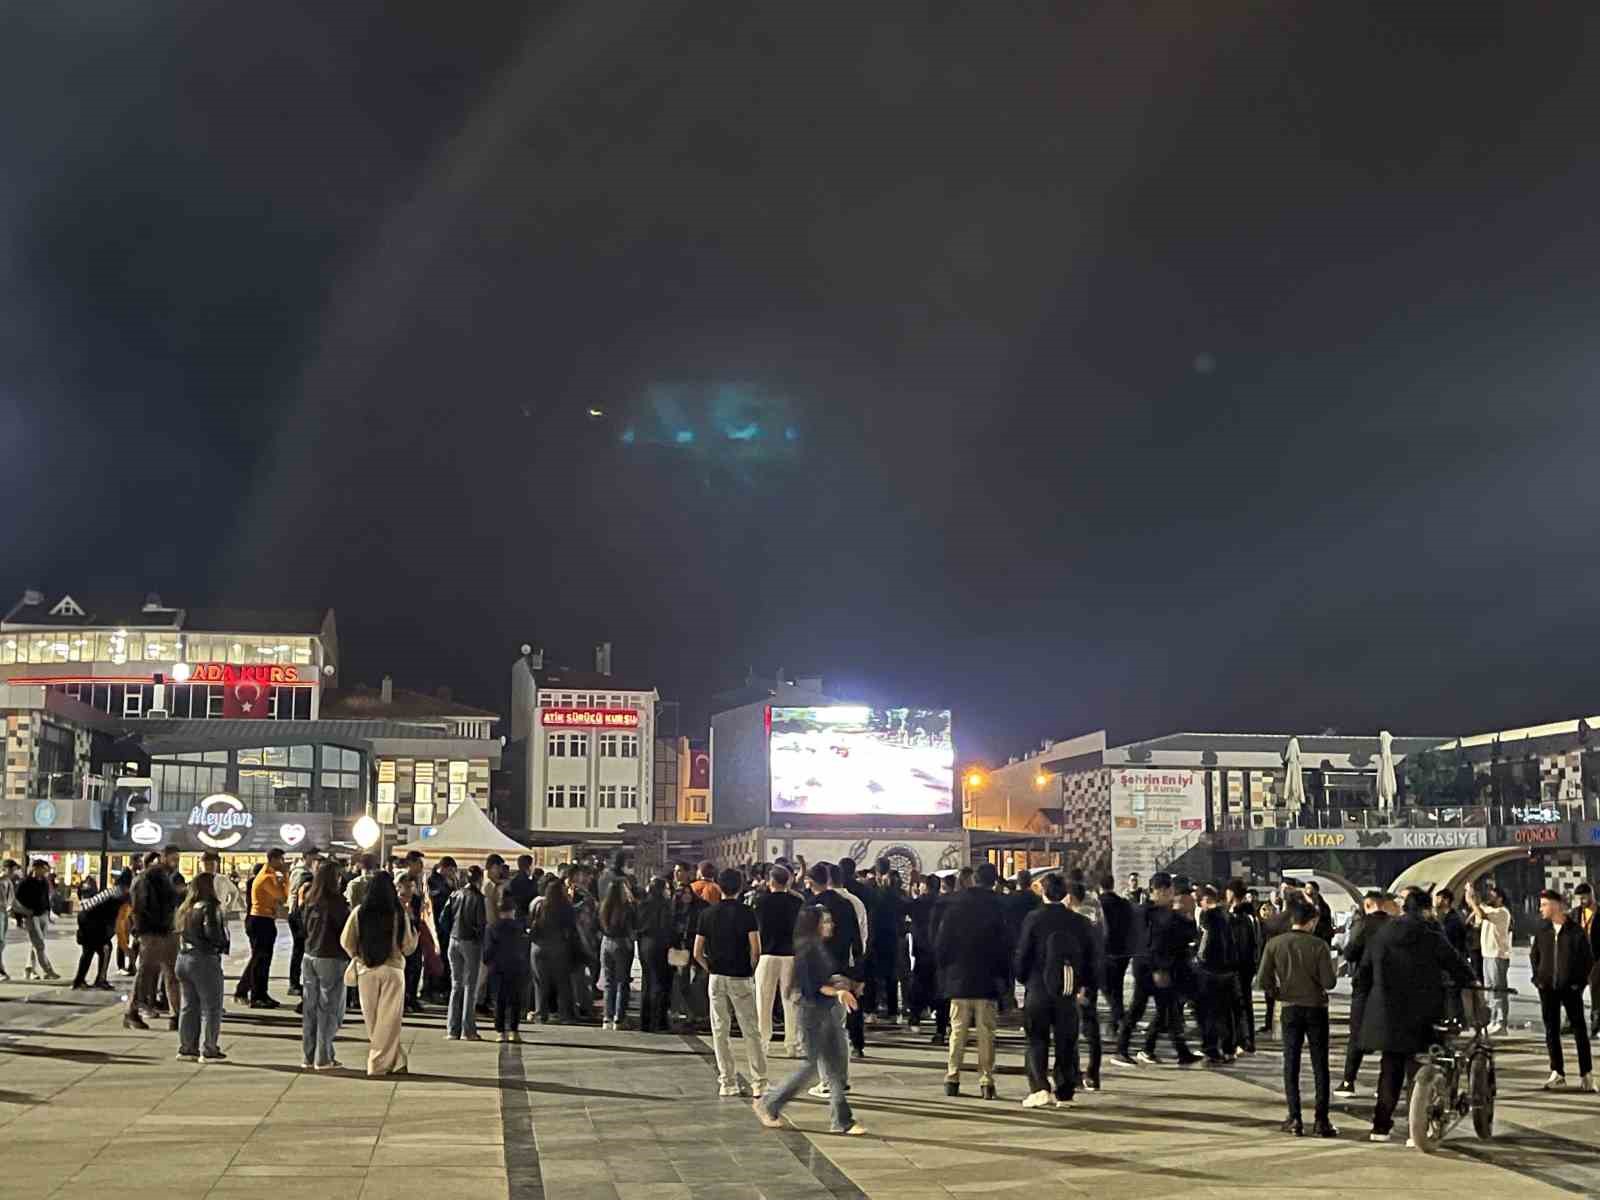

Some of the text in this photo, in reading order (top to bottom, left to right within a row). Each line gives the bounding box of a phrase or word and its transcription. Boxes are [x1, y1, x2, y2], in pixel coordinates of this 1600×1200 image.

[191, 663, 299, 682] ADA KURS
[188, 805, 253, 835] Meydan
[1303, 831, 1478, 847] KİTAP KIRTASİYE
